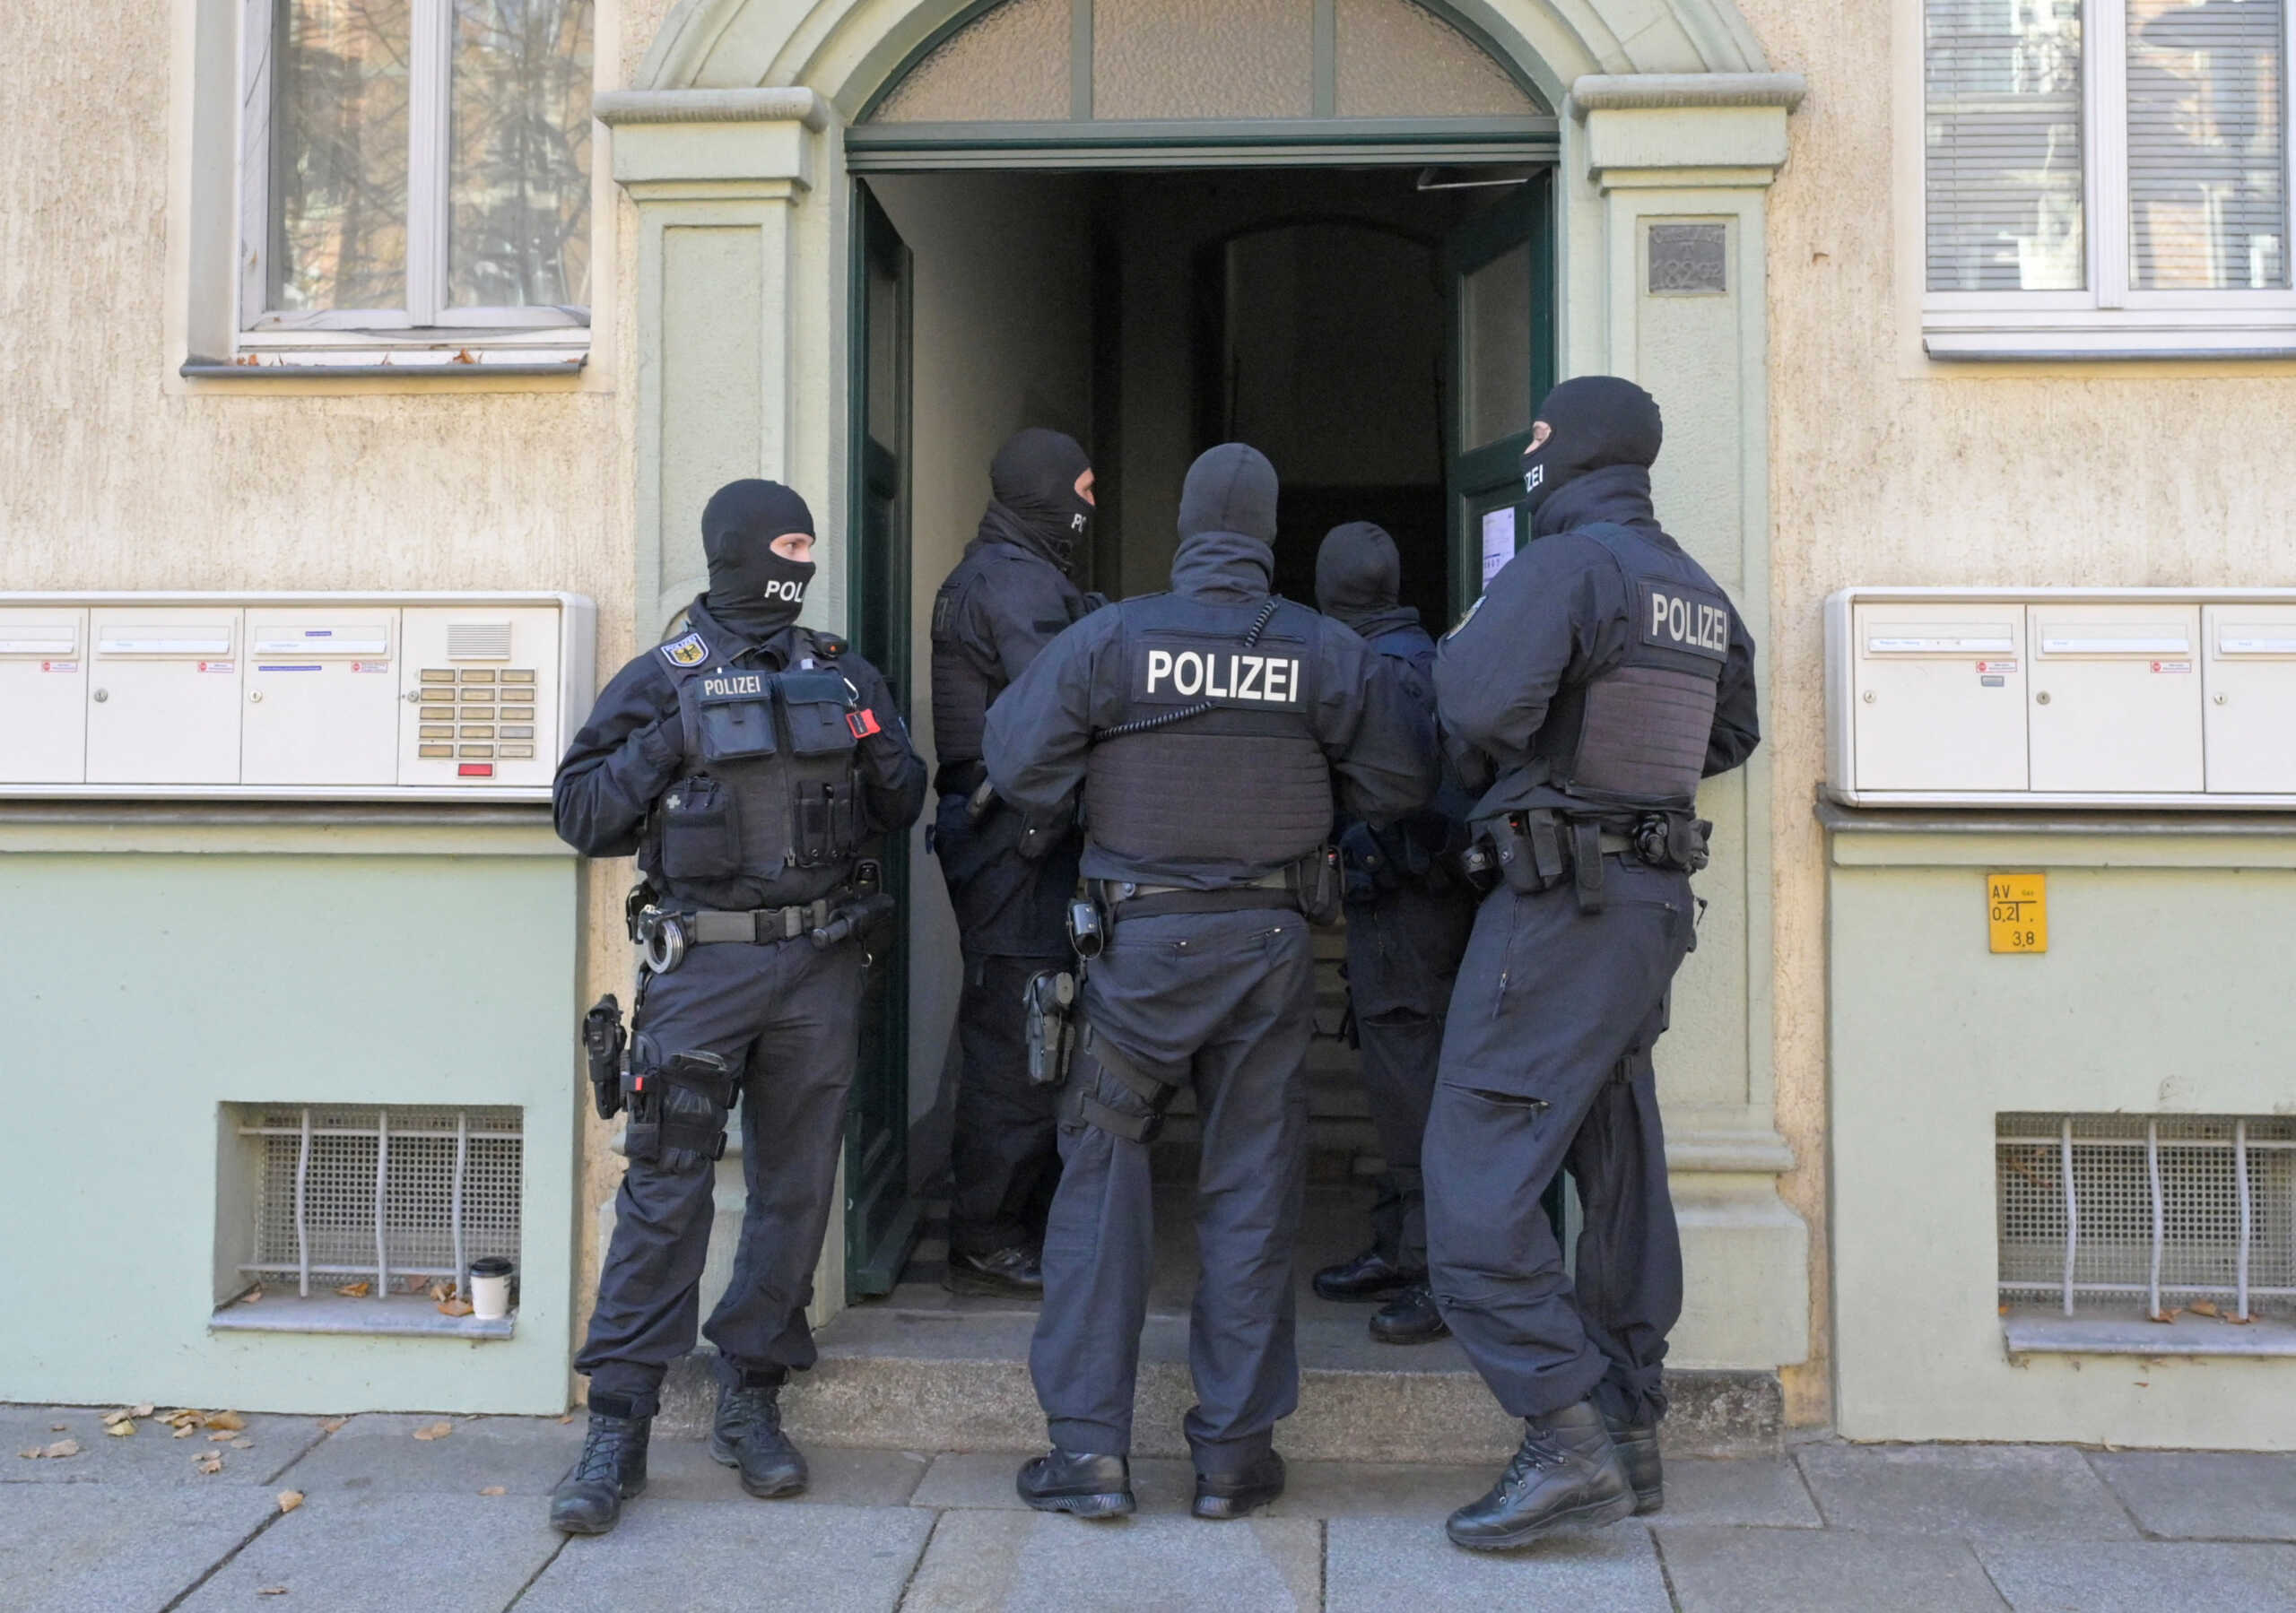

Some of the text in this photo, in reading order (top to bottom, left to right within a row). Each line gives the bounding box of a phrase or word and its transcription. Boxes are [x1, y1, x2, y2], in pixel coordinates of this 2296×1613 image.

[1524, 464, 1543, 493] ZEI
[764, 580, 804, 603] POL
[1652, 593, 1727, 653] POLIZEI
[704, 675, 761, 696] POLIZEI
[1147, 650, 1299, 702] POLIZEI
[1993, 884, 2010, 898] AV
